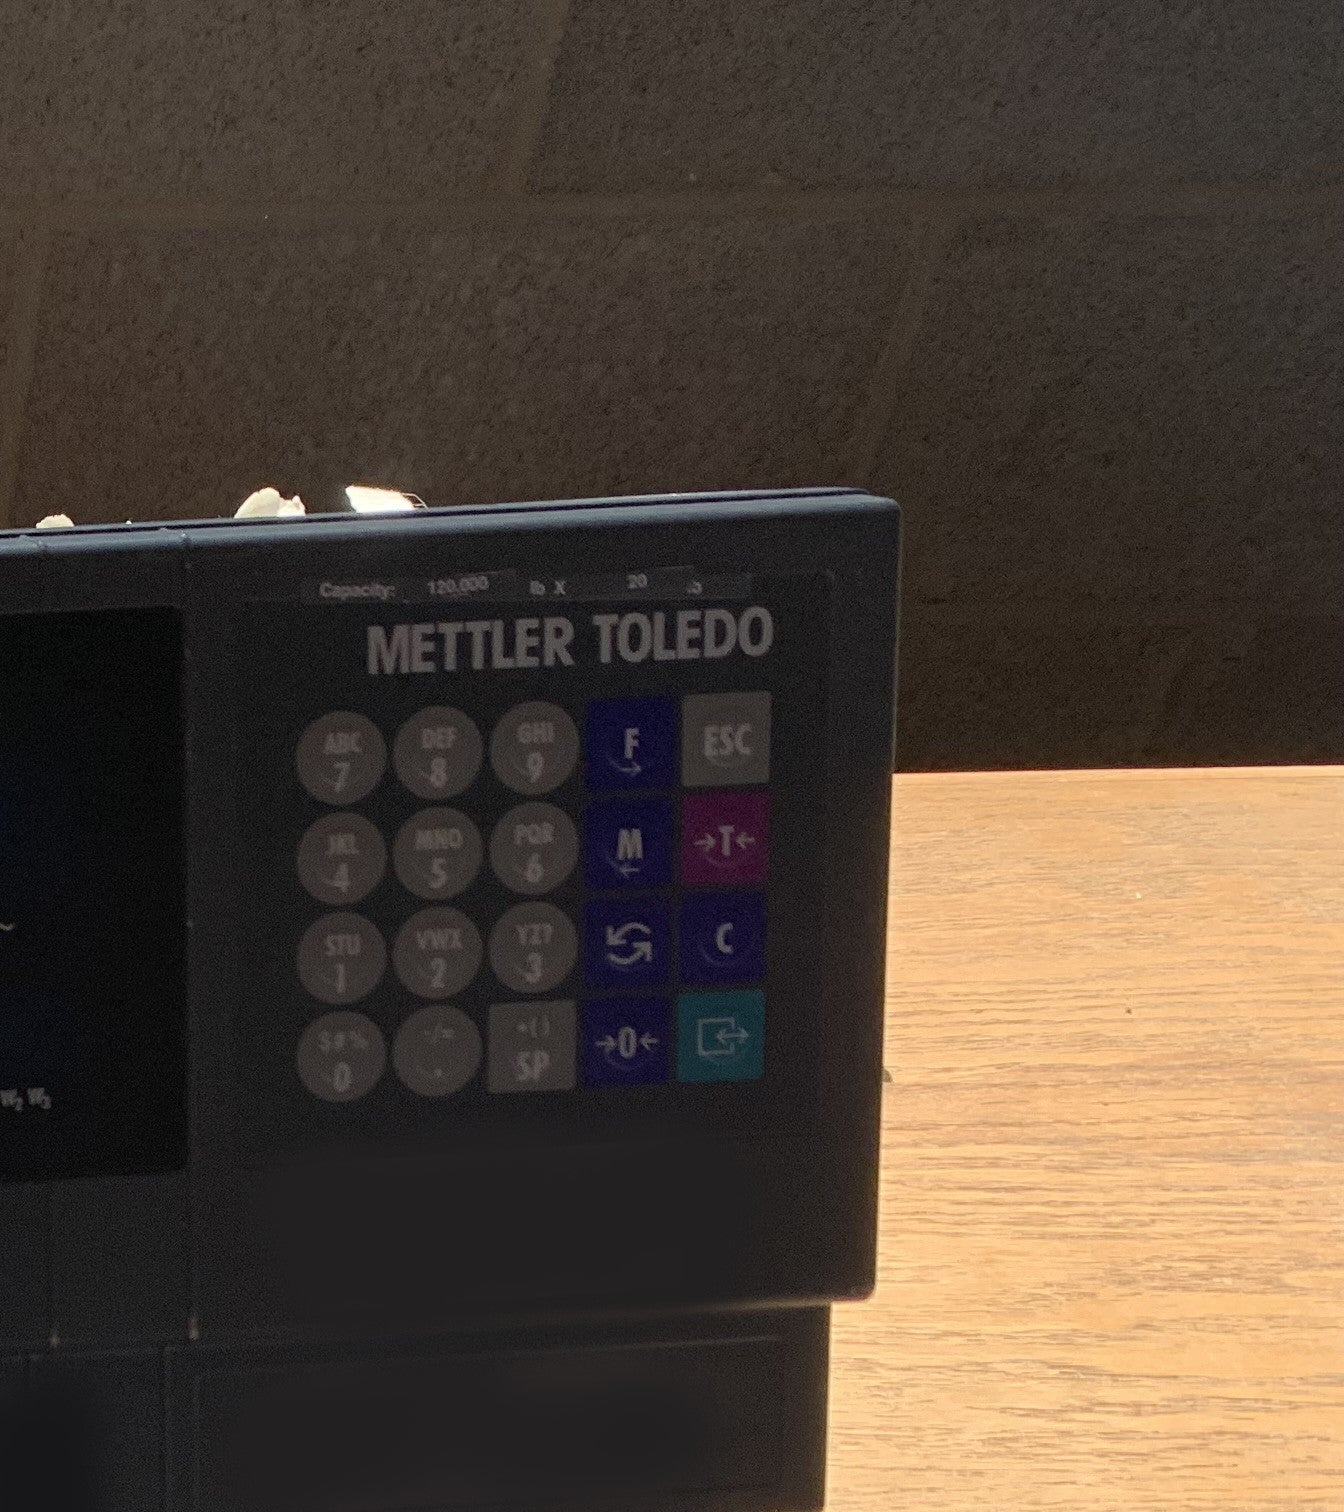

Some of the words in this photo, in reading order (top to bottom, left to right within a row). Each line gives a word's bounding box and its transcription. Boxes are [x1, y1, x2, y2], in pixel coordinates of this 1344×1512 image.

[319, 582, 397, 602] Capacity:
[626, 573, 648, 590] 20
[366, 615, 576, 676] METTLER
[593, 606, 774, 664] TOLEDO
[323, 731, 362, 755] ABC
[420, 727, 457, 750] DEF
[516, 721, 555, 745] GHI
[623, 728, 640, 760] F
[704, 723, 753, 758] ESC
[334, 762, 350, 793] 7
[429, 758, 448, 788] 8
[527, 752, 544, 783] 9
[415, 827, 462, 851] MNO
[514, 823, 553, 848] PQR
[617, 828, 644, 860] M
[332, 862, 350, 891] 4
[429, 860, 446, 889] 5
[526, 854, 543, 884] 6
[324, 931, 361, 957] STU
[415, 927, 463, 951] VWX
[715, 921, 734, 955] C
[334, 963, 346, 994] 1
[430, 958, 446, 989] 2
[525, 953, 543, 985] 3
[332, 1062, 352, 1093] 0
[517, 1050, 551, 1083] SP
